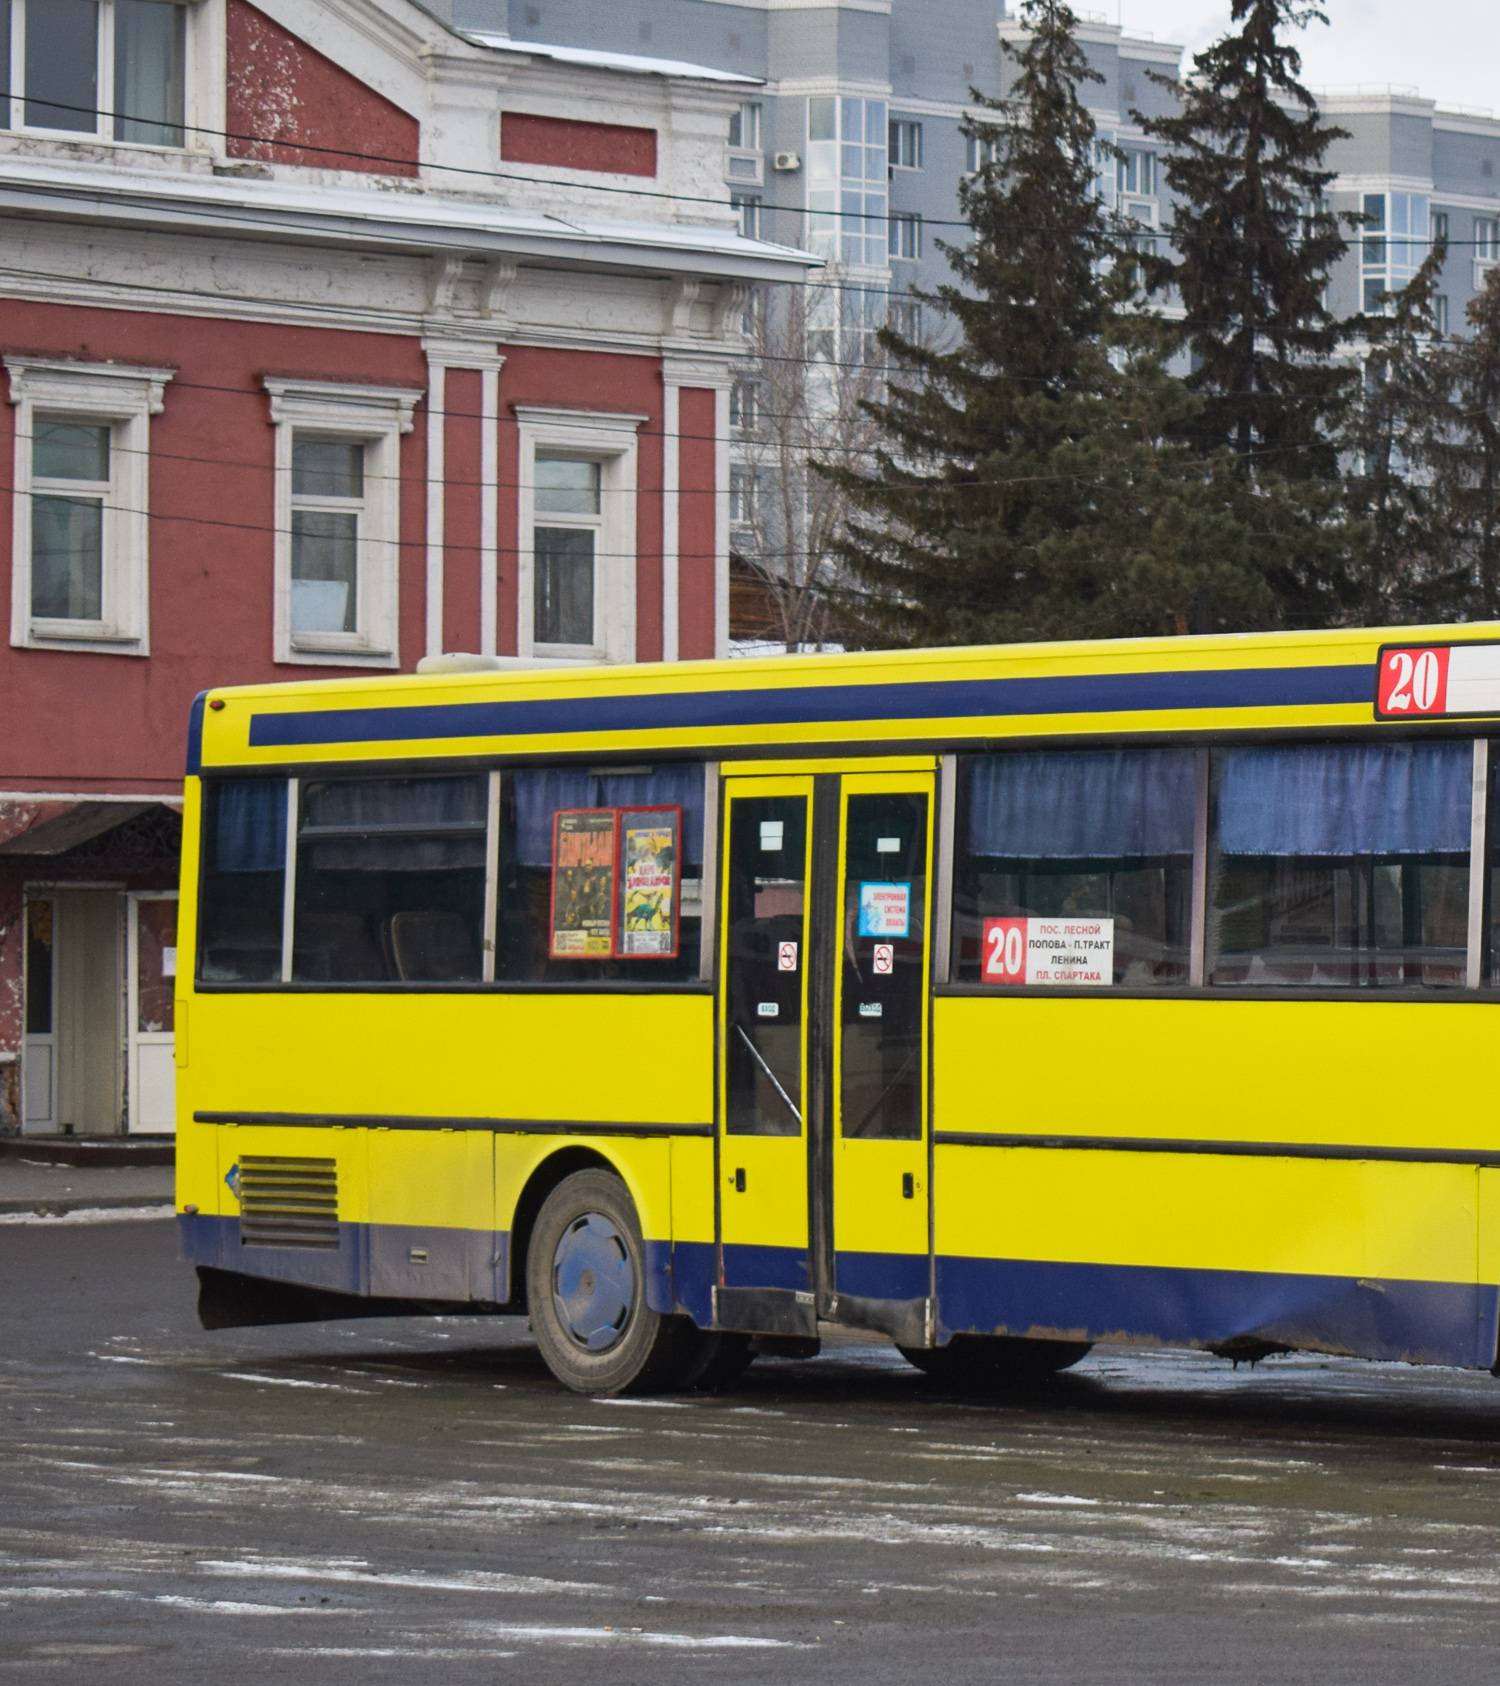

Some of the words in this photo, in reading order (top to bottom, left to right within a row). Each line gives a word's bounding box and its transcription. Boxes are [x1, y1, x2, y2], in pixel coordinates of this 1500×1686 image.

[1387, 651, 1439, 710] 20
[1040, 925, 1061, 935] ПОС.
[1064, 924, 1101, 935] ЛЕСНОЙ
[1029, 940, 1066, 949] ПОПОВА
[1074, 940, 1111, 950] П.ТРАКТ
[986, 926, 1023, 975] 20
[1050, 956, 1088, 965] ЛЕНИНА
[1036, 971, 1052, 980] ПЛ.
[1054, 971, 1101, 981] СПАРТАКА
